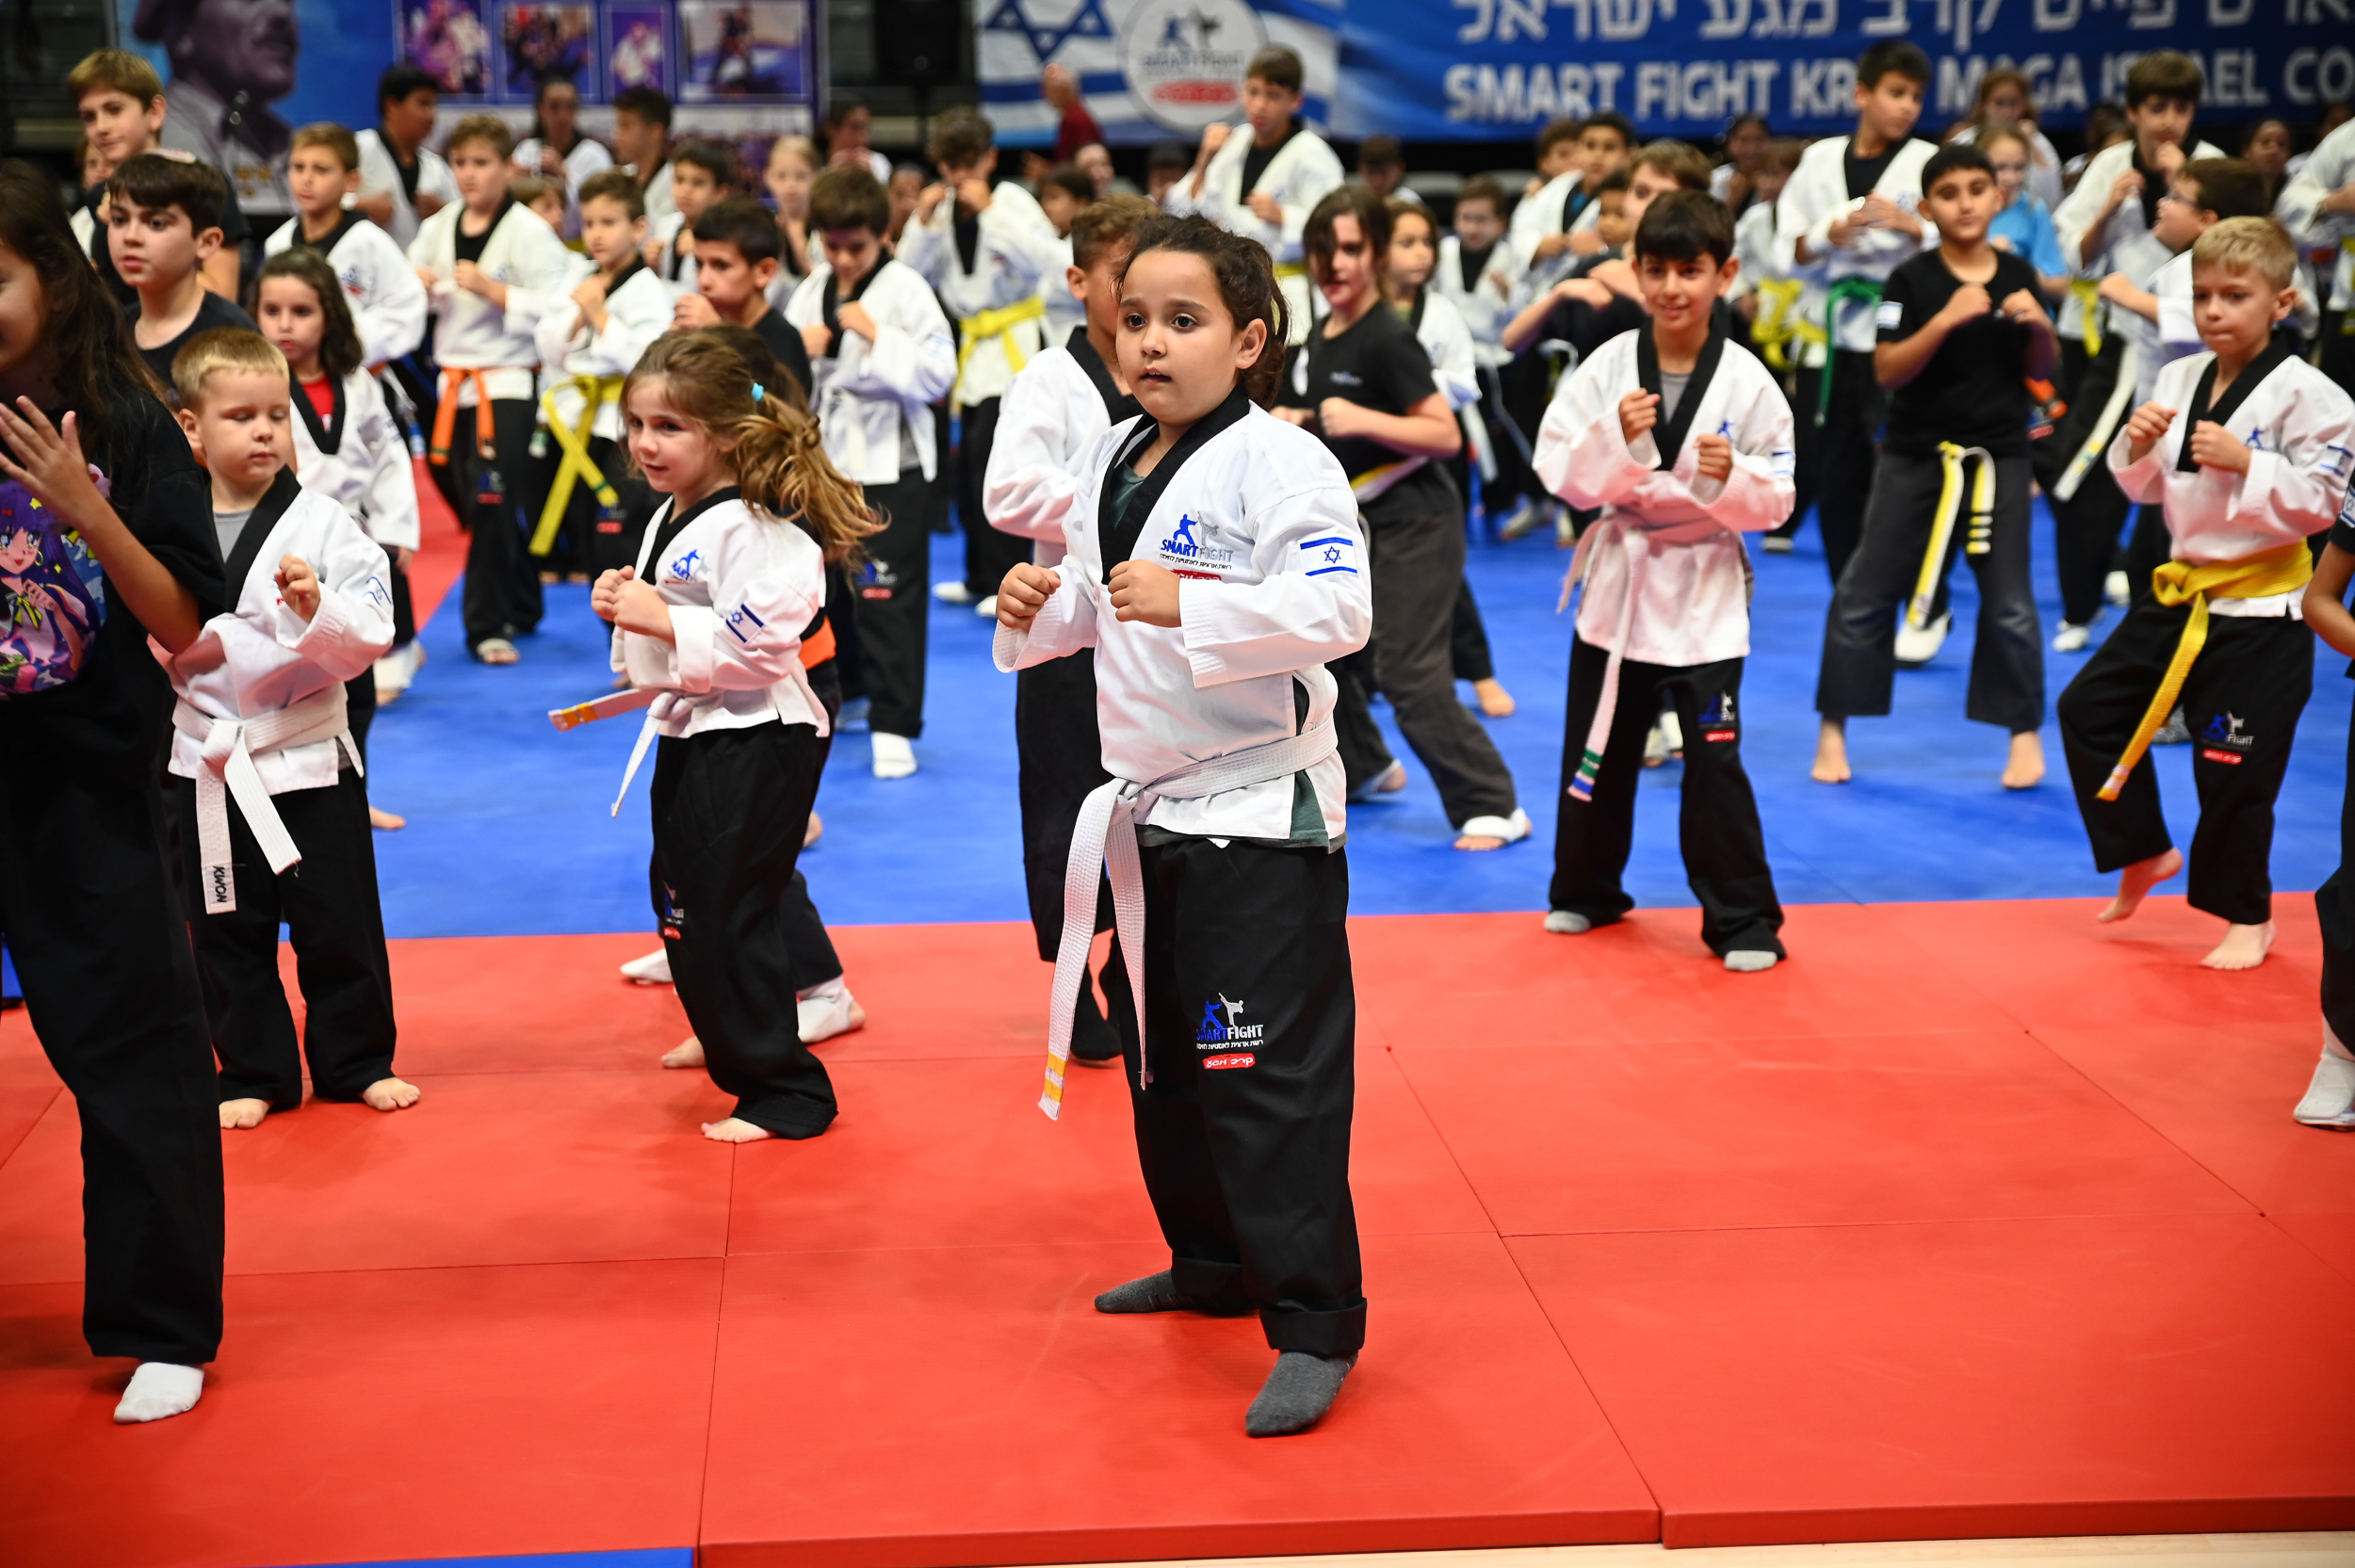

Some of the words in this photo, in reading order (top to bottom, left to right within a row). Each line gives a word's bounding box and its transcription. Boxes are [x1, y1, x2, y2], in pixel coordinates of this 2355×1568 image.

[1443, 61, 1626, 123] SMART
[1634, 58, 1781, 121] FIGHT
[1936, 52, 2089, 113] MGA
[213, 865, 227, 903] KWON
